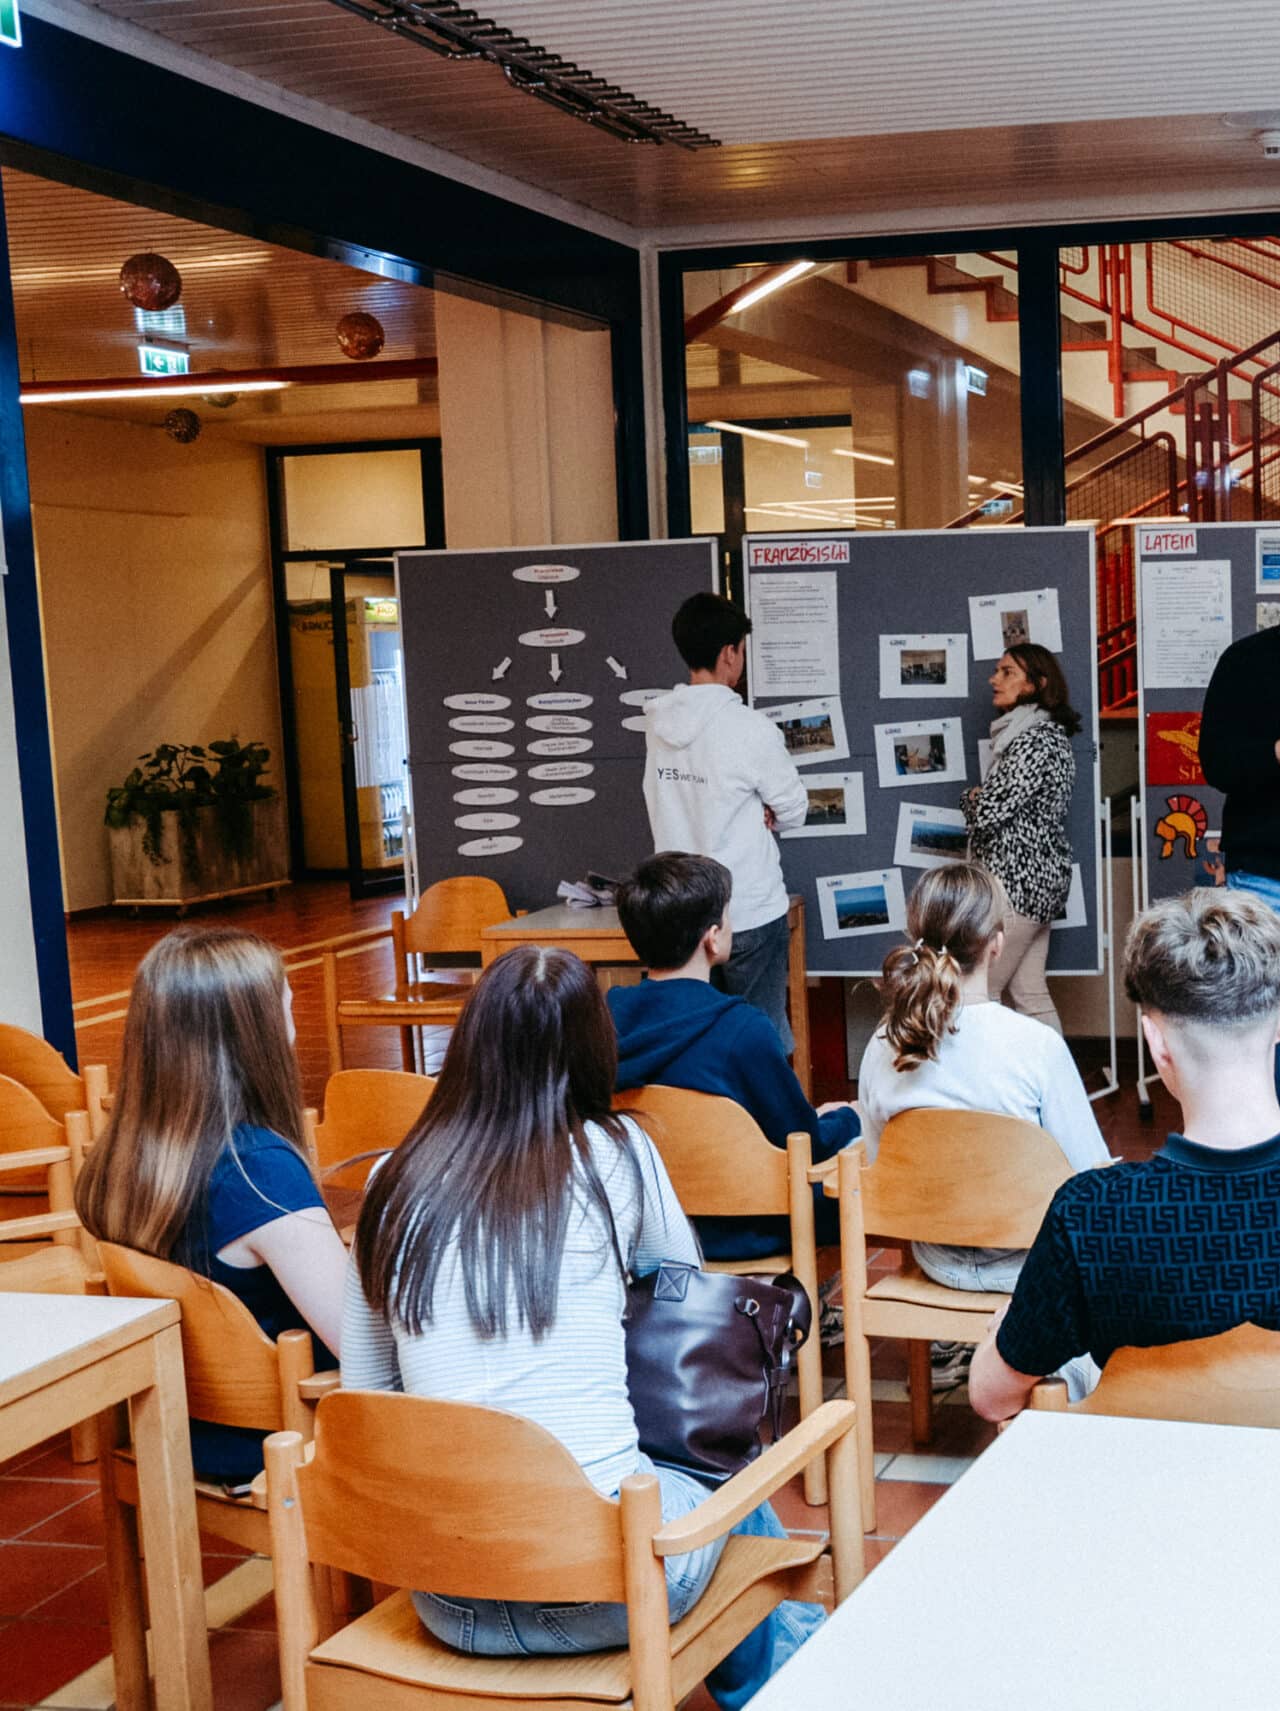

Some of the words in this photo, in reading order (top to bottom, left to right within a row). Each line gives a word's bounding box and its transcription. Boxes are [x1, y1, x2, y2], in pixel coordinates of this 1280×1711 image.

[1145, 533, 1195, 552] LATEIN
[753, 542, 848, 565] FRANZÖSISCH
[657, 767, 680, 781] YES
